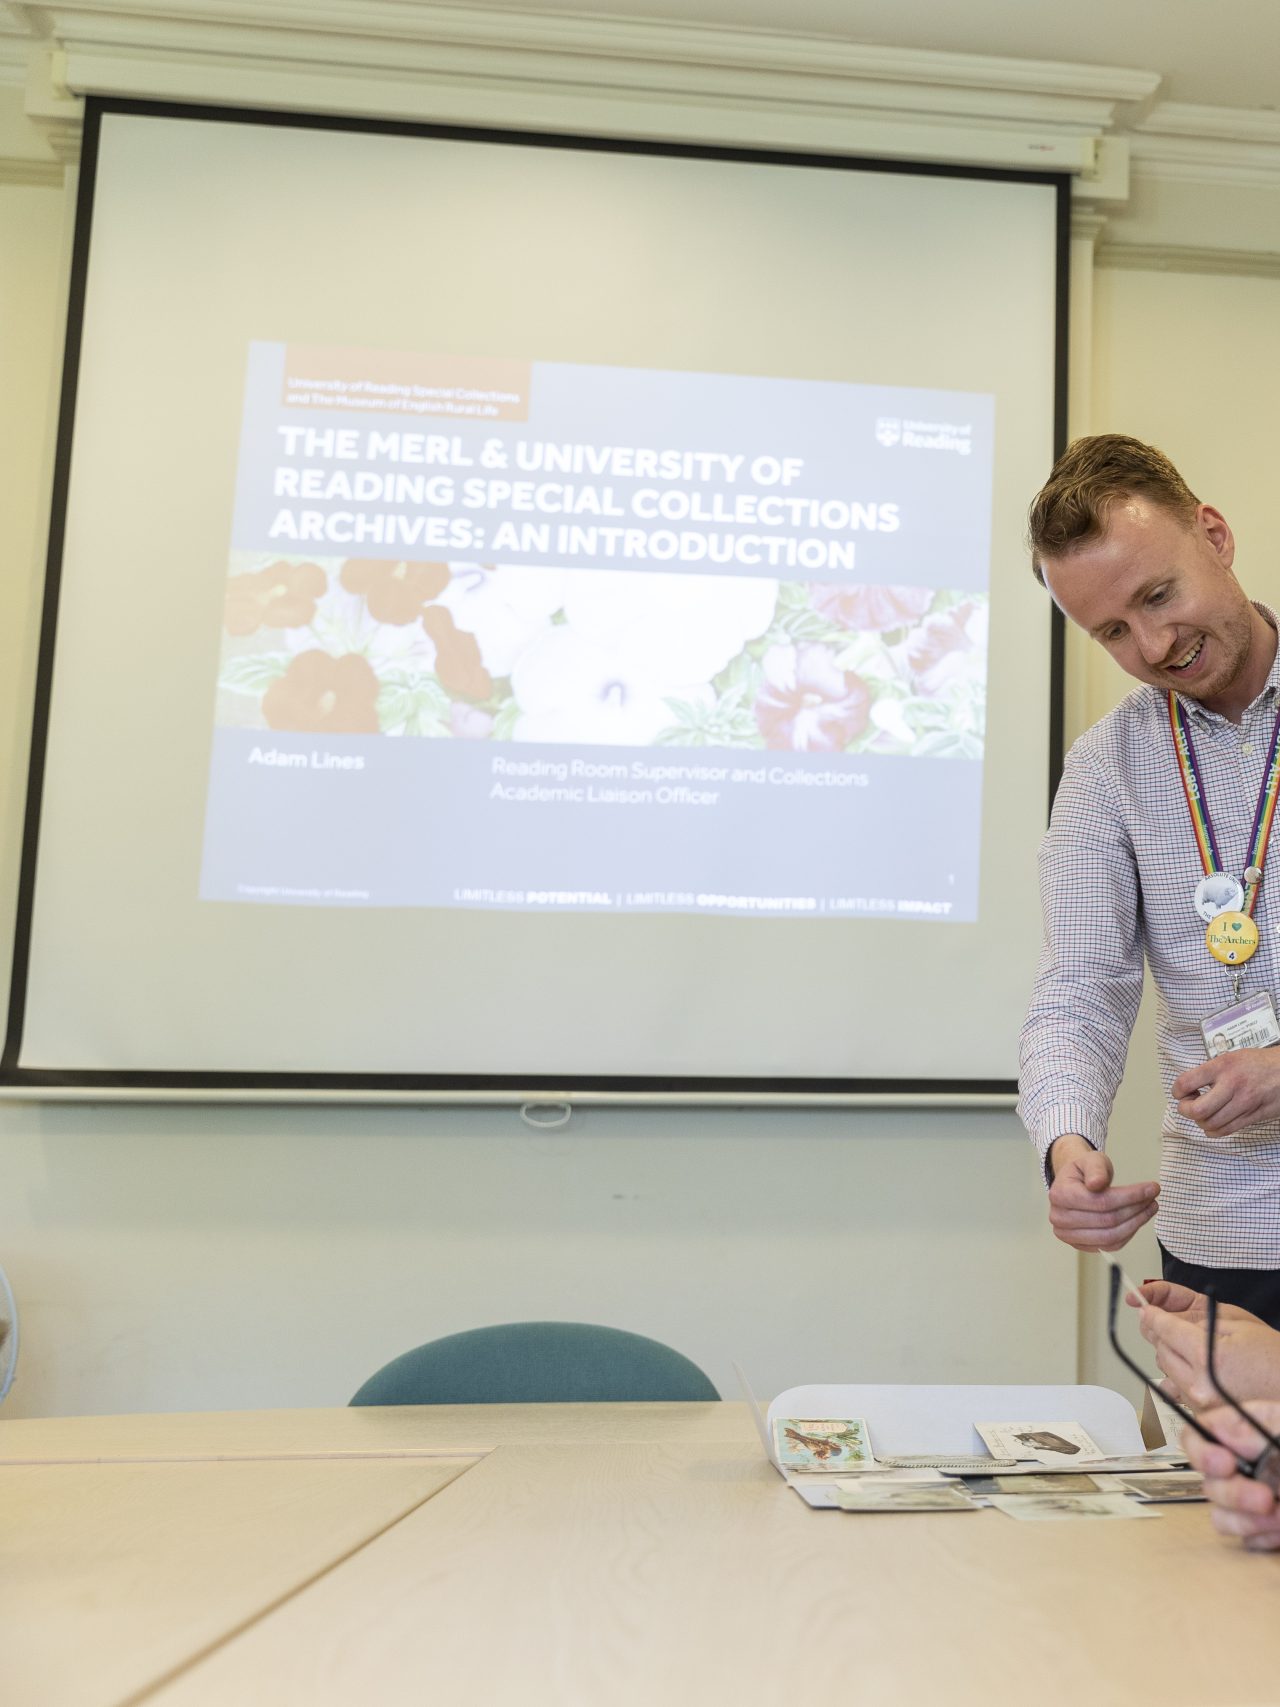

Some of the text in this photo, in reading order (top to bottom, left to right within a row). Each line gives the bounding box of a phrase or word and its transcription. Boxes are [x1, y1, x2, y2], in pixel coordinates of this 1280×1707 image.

[287, 377, 348, 392] University
[364, 381, 411, 398] Reading
[413, 384, 452, 400] Special
[454, 387, 520, 405] Collections
[287, 392, 310, 404] and
[311, 392, 333, 405] The
[335, 395, 388, 409] Museum
[402, 399, 443, 414] English
[278, 425, 804, 486] THE MERL & UNIVERSITY OF
[903, 431, 971, 456] Reading
[273, 466, 900, 533] READING SPECIAL COLLECTIONS
[268, 508, 856, 571] ARCHIVES: AN INTRODUCTION
[247, 746, 365, 771] Adam Lines
[492, 756, 869, 788] Reading Room Supervisor and Collections
[489, 781, 720, 806] Academic Liaison Officer
[453, 887, 524, 904] LIMITLESS
[526, 890, 612, 905] POTENTIAL
[625, 892, 694, 906] LIMITLESS
[696, 894, 816, 911] OPPORTUNITIES
[829, 897, 895, 912] LIMITLESS
[897, 900, 952, 915] IMPACT
[1223, 922, 1227, 931] I
